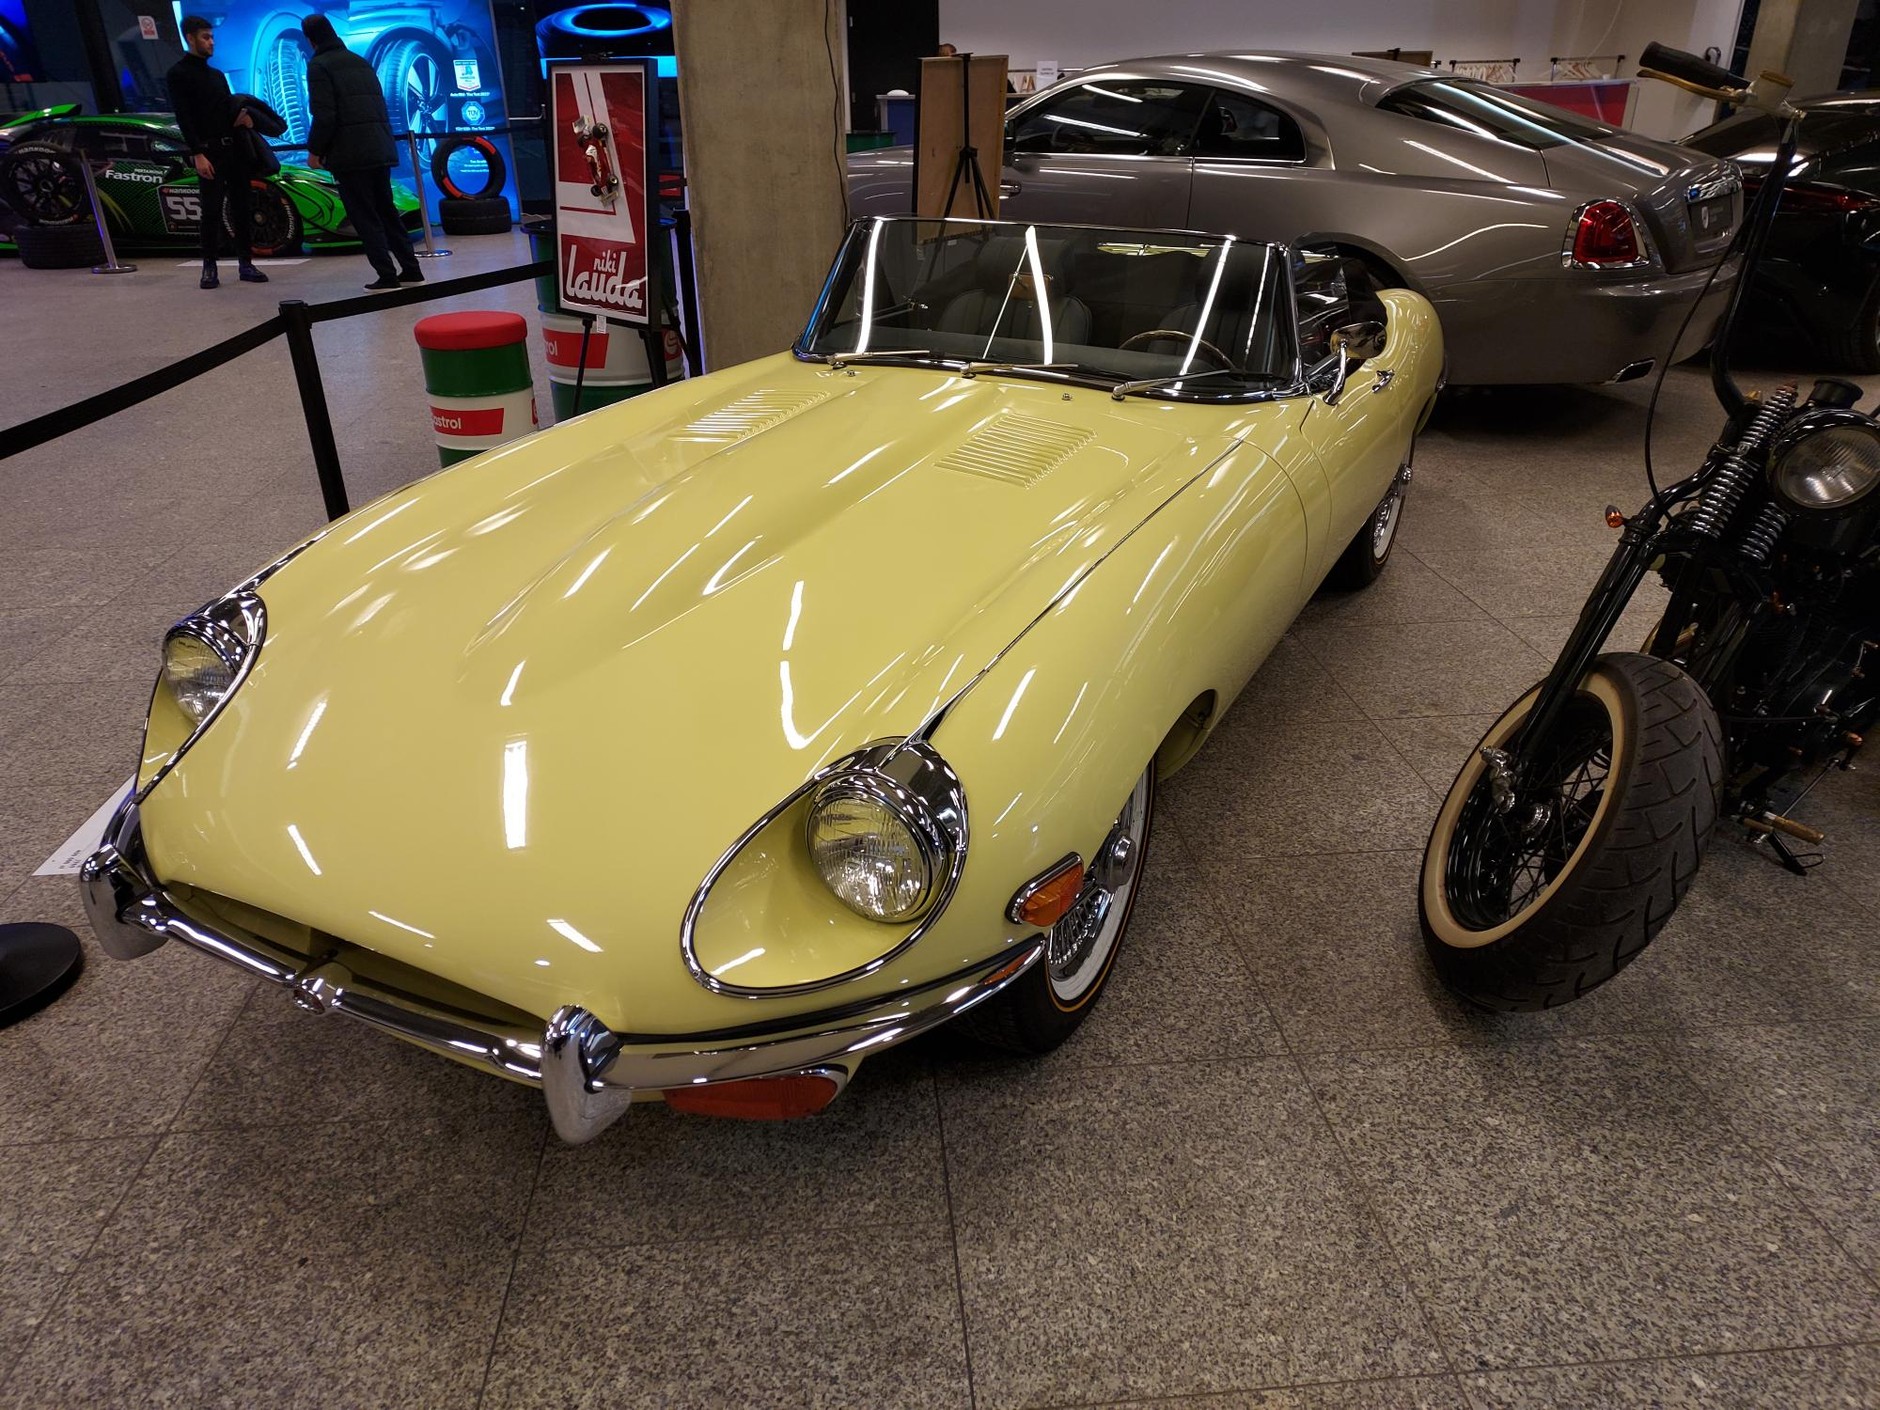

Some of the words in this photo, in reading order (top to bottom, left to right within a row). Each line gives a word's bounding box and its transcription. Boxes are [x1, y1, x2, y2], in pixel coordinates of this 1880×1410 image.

[105, 169, 163, 184] Fastron
[166, 196, 202, 220] 55
[593, 249, 617, 273] niki
[566, 244, 643, 309] lauda
